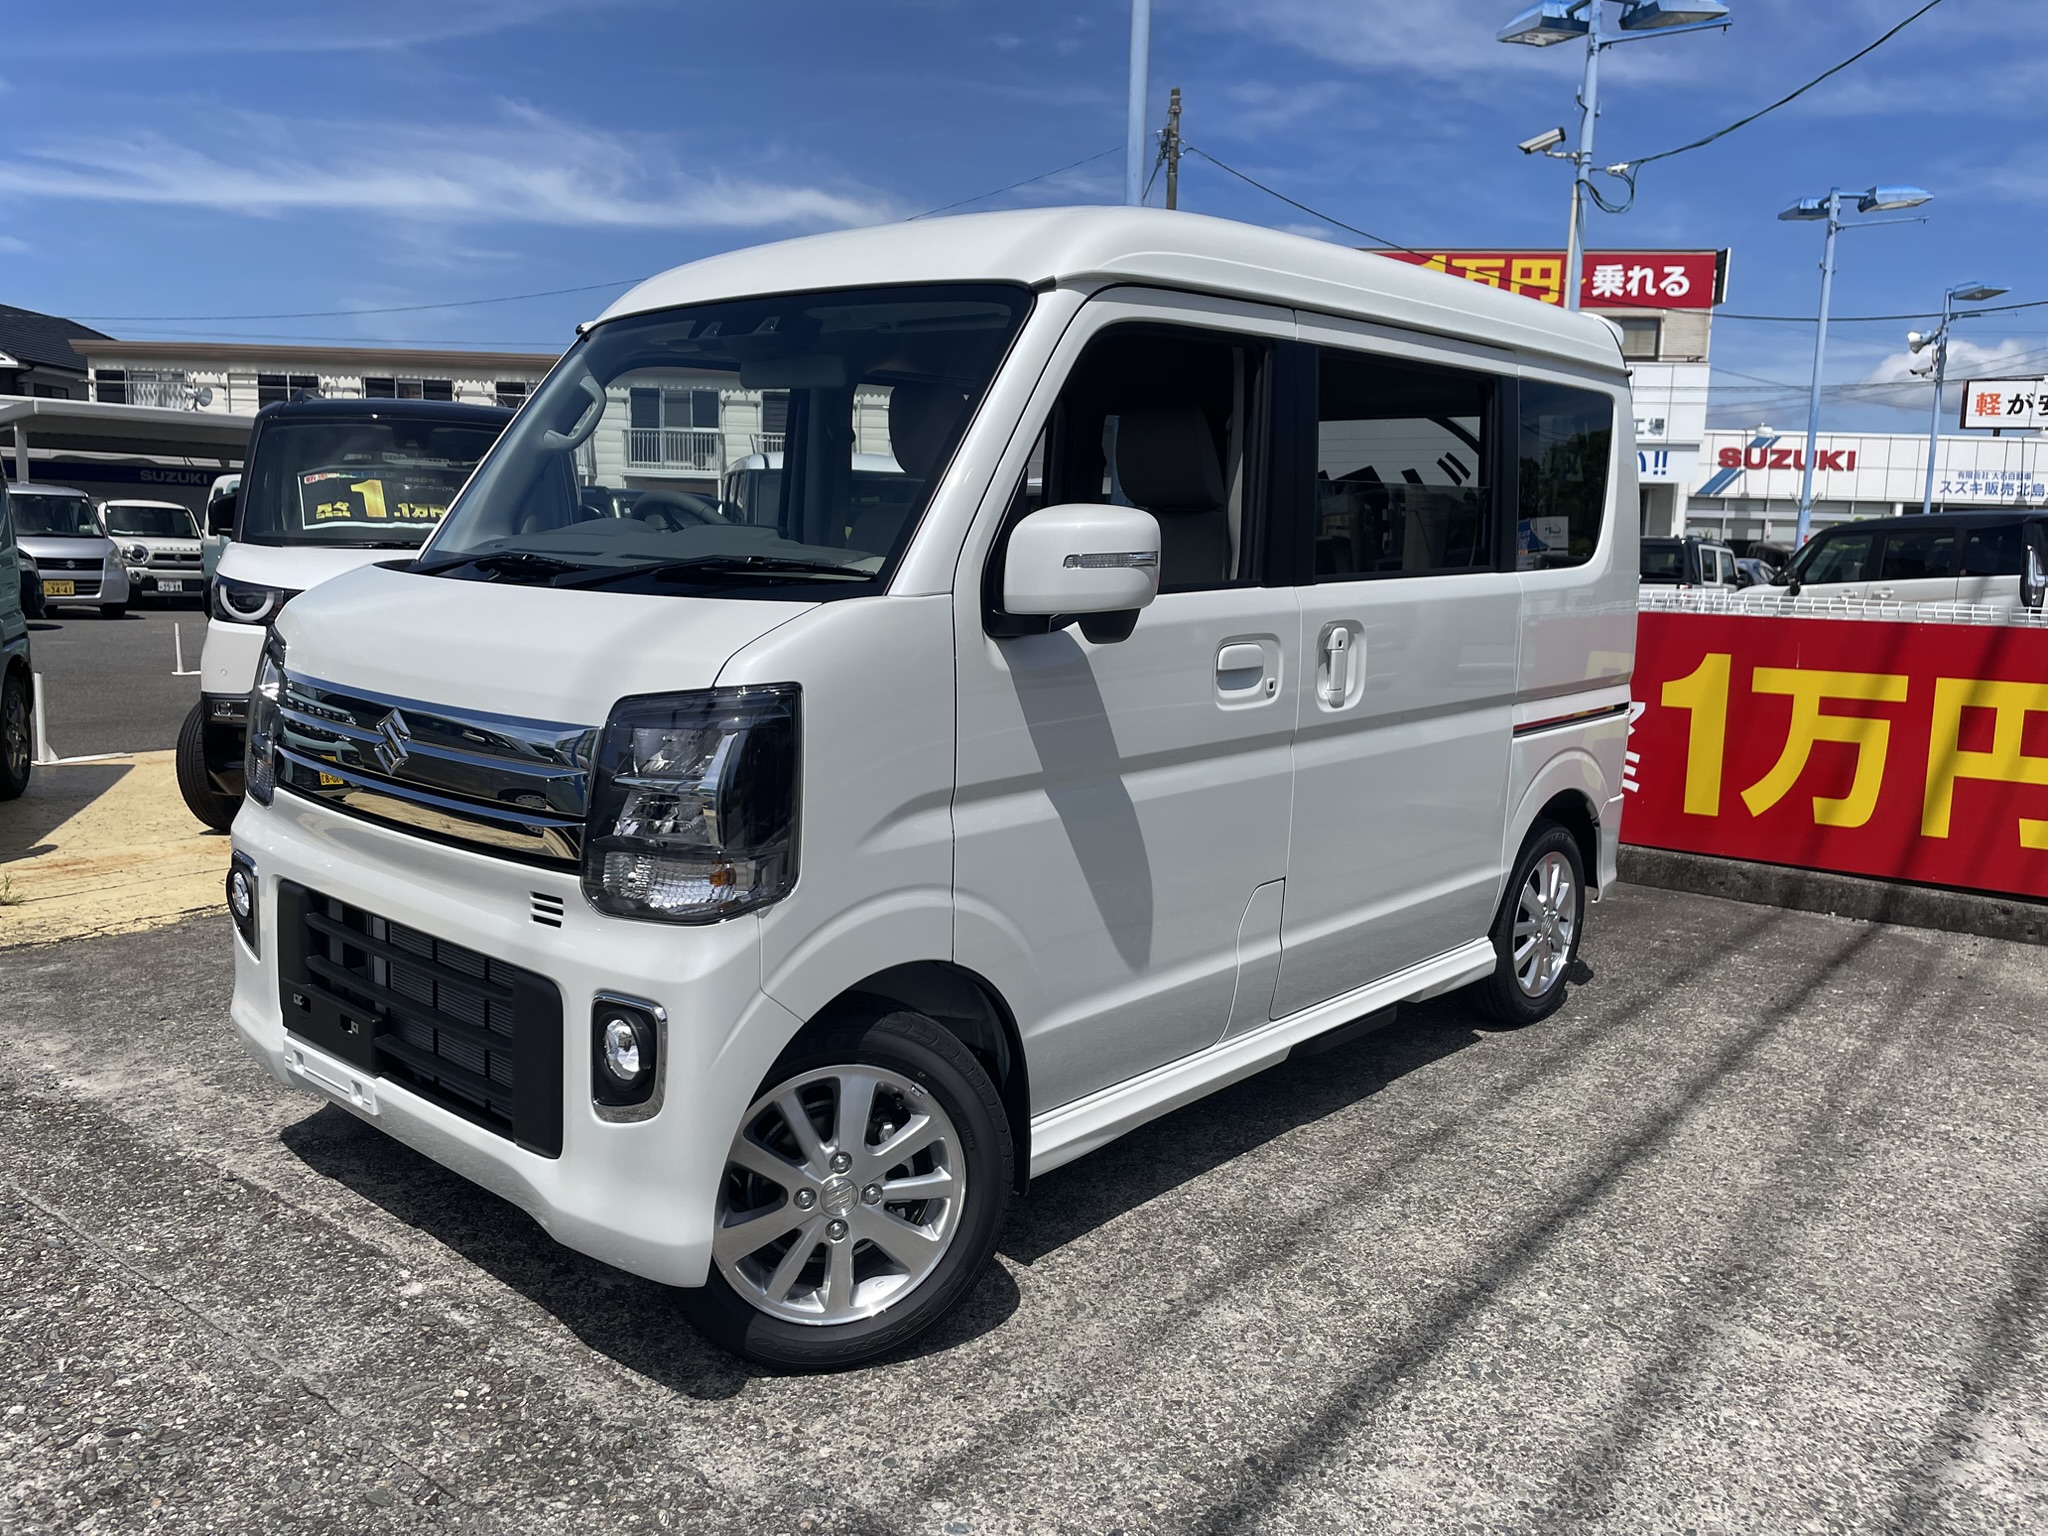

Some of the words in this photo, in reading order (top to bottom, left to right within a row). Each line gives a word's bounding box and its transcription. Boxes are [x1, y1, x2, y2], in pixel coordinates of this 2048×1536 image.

[1591, 264, 1690, 297] 乗れる
[1718, 447, 1856, 471] SUZUKI
[140, 469, 208, 484] SUZUKI
[1940, 481, 2048, 497] スズキ販売北島
[1661, 653, 2048, 850] 1万円
